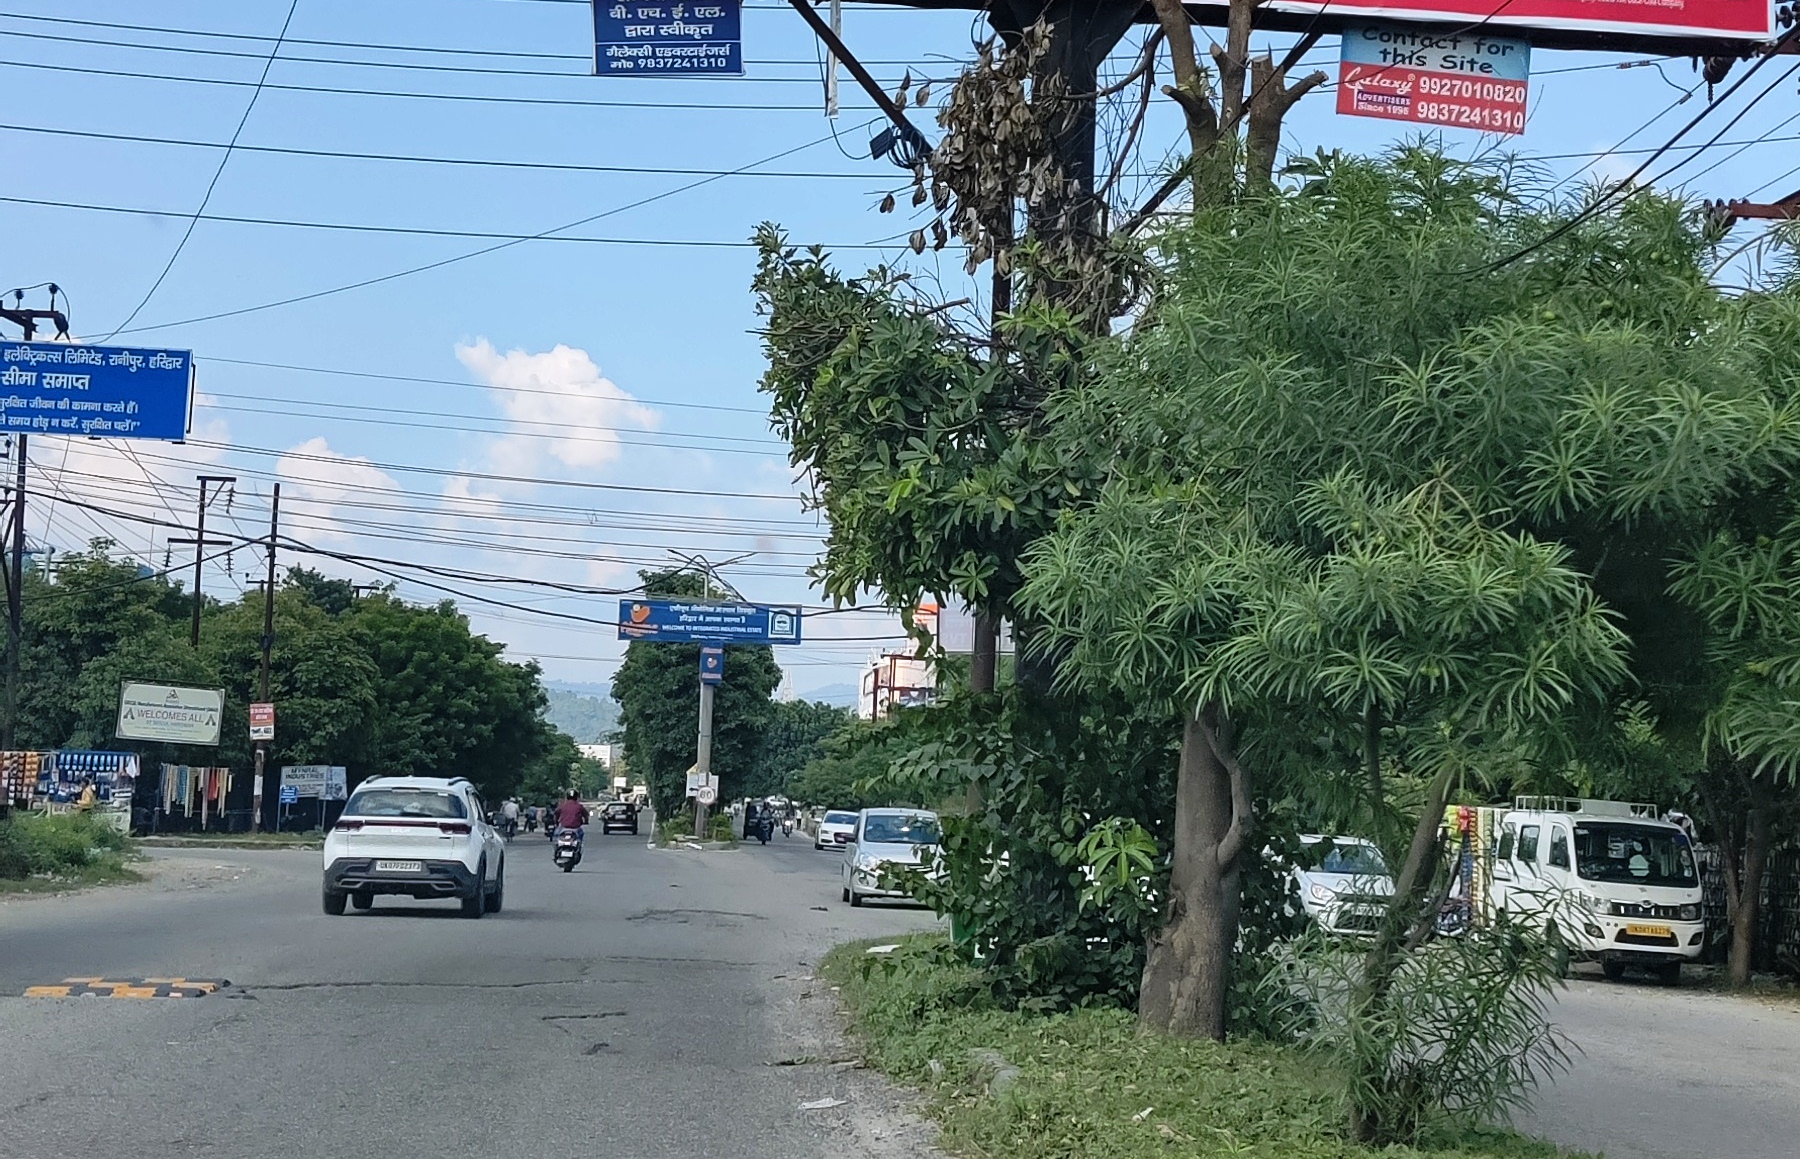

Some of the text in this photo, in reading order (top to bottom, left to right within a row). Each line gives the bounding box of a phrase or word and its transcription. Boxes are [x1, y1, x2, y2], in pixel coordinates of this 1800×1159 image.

[658, 21, 714, 39] स्वीकृत
[1361, 26, 1514, 56] Contact for
[637, 58, 726, 68] 9837241310
[1379, 47, 1493, 74] this Site
[1419, 76, 1526, 104] 9927010820
[1417, 101, 1524, 129] 9837241310
[1, 366, 91, 390] सीमा समाप्त
[136, 709, 204, 723] WELCOMES ALL
